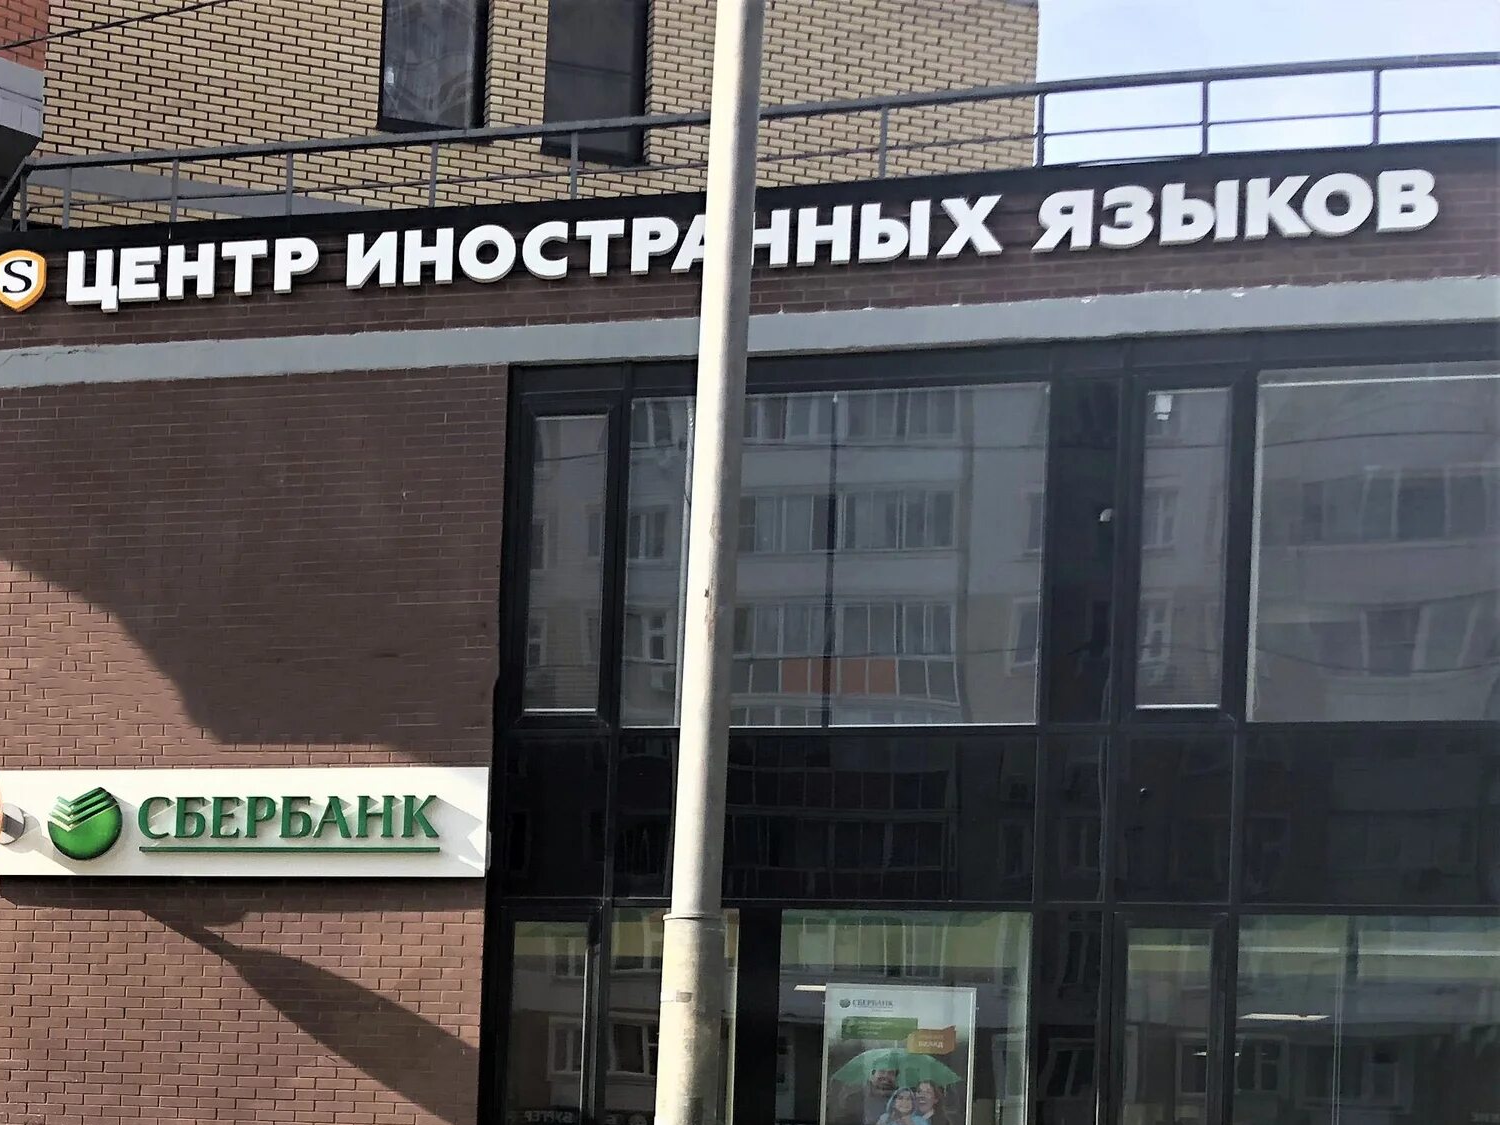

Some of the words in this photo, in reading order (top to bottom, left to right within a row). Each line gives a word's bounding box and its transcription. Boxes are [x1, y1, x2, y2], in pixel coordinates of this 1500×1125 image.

[65, 238, 320, 313] ЦЕНТР
[1031, 168, 1440, 253] ЯЗЫКОВ
[139, 795, 441, 839] СБЕРБАНК
